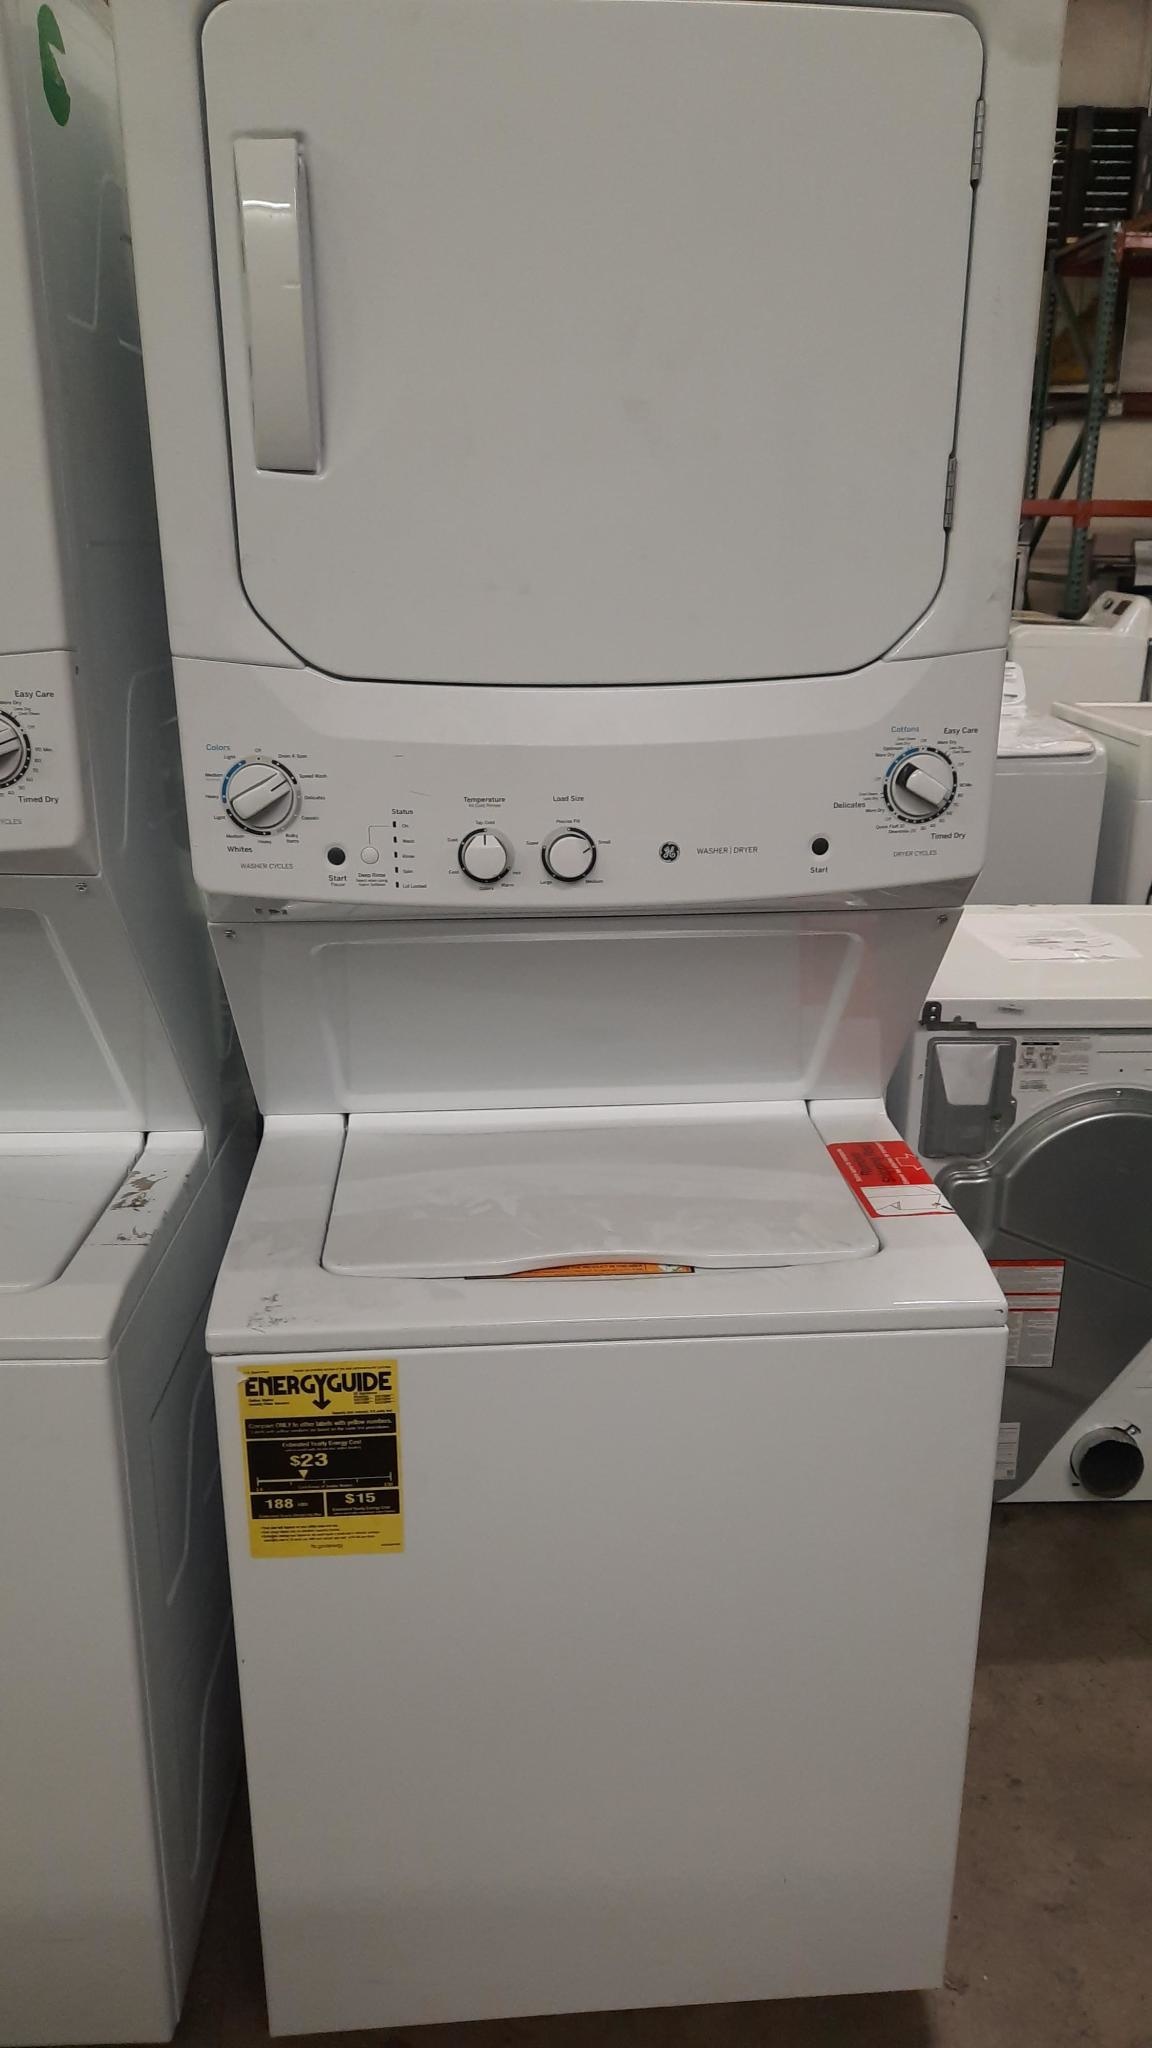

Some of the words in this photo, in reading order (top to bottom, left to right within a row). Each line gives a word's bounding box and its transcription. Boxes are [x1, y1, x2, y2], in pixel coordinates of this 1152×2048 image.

[15, 690, 33, 698] Easy
[45, 795, 59, 804] Dry
[954, 832, 966, 840] Dry
[733, 846, 758, 854] DRYER
[245, 1372, 392, 1401] ENERGYGUIDE
[290, 1453, 328, 1467] $23
[345, 1493, 376, 1503] $15
[265, 1499, 294, 1509] 188
